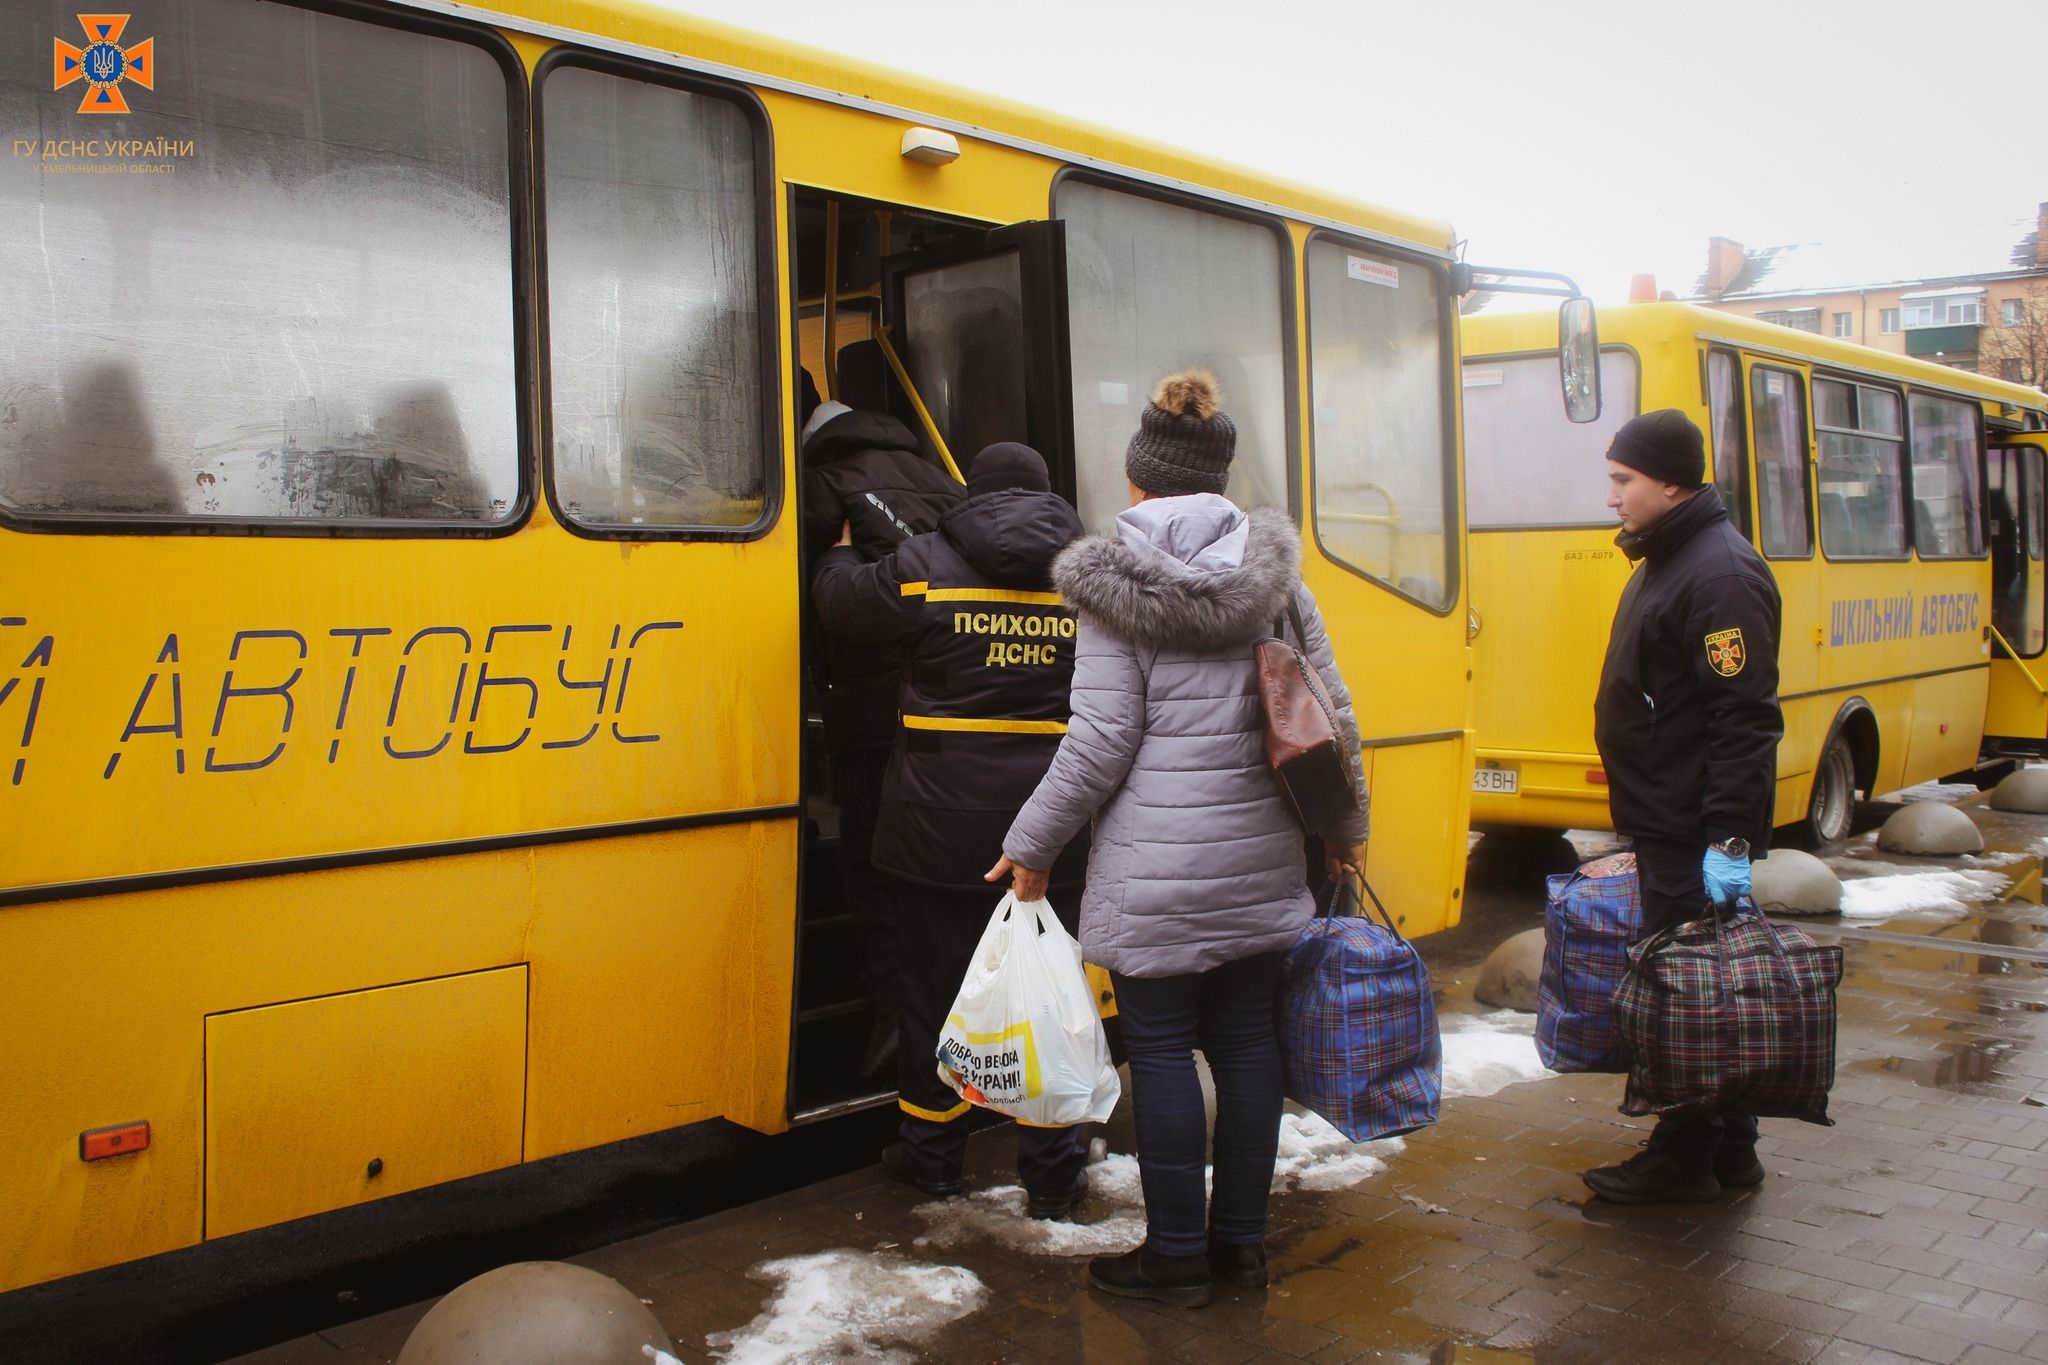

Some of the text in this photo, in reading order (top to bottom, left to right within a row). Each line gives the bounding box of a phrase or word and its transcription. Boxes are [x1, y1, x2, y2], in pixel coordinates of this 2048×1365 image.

[1564, 552, 1583, 560] БАЗ
[954, 612, 1079, 638] ПСИХОЛО
[1830, 591, 1979, 647] ШКІЛЬНИЙ АВТОБУС
[985, 642, 1057, 667] ДСНС
[103, 621, 684, 780] АВТОБУС
